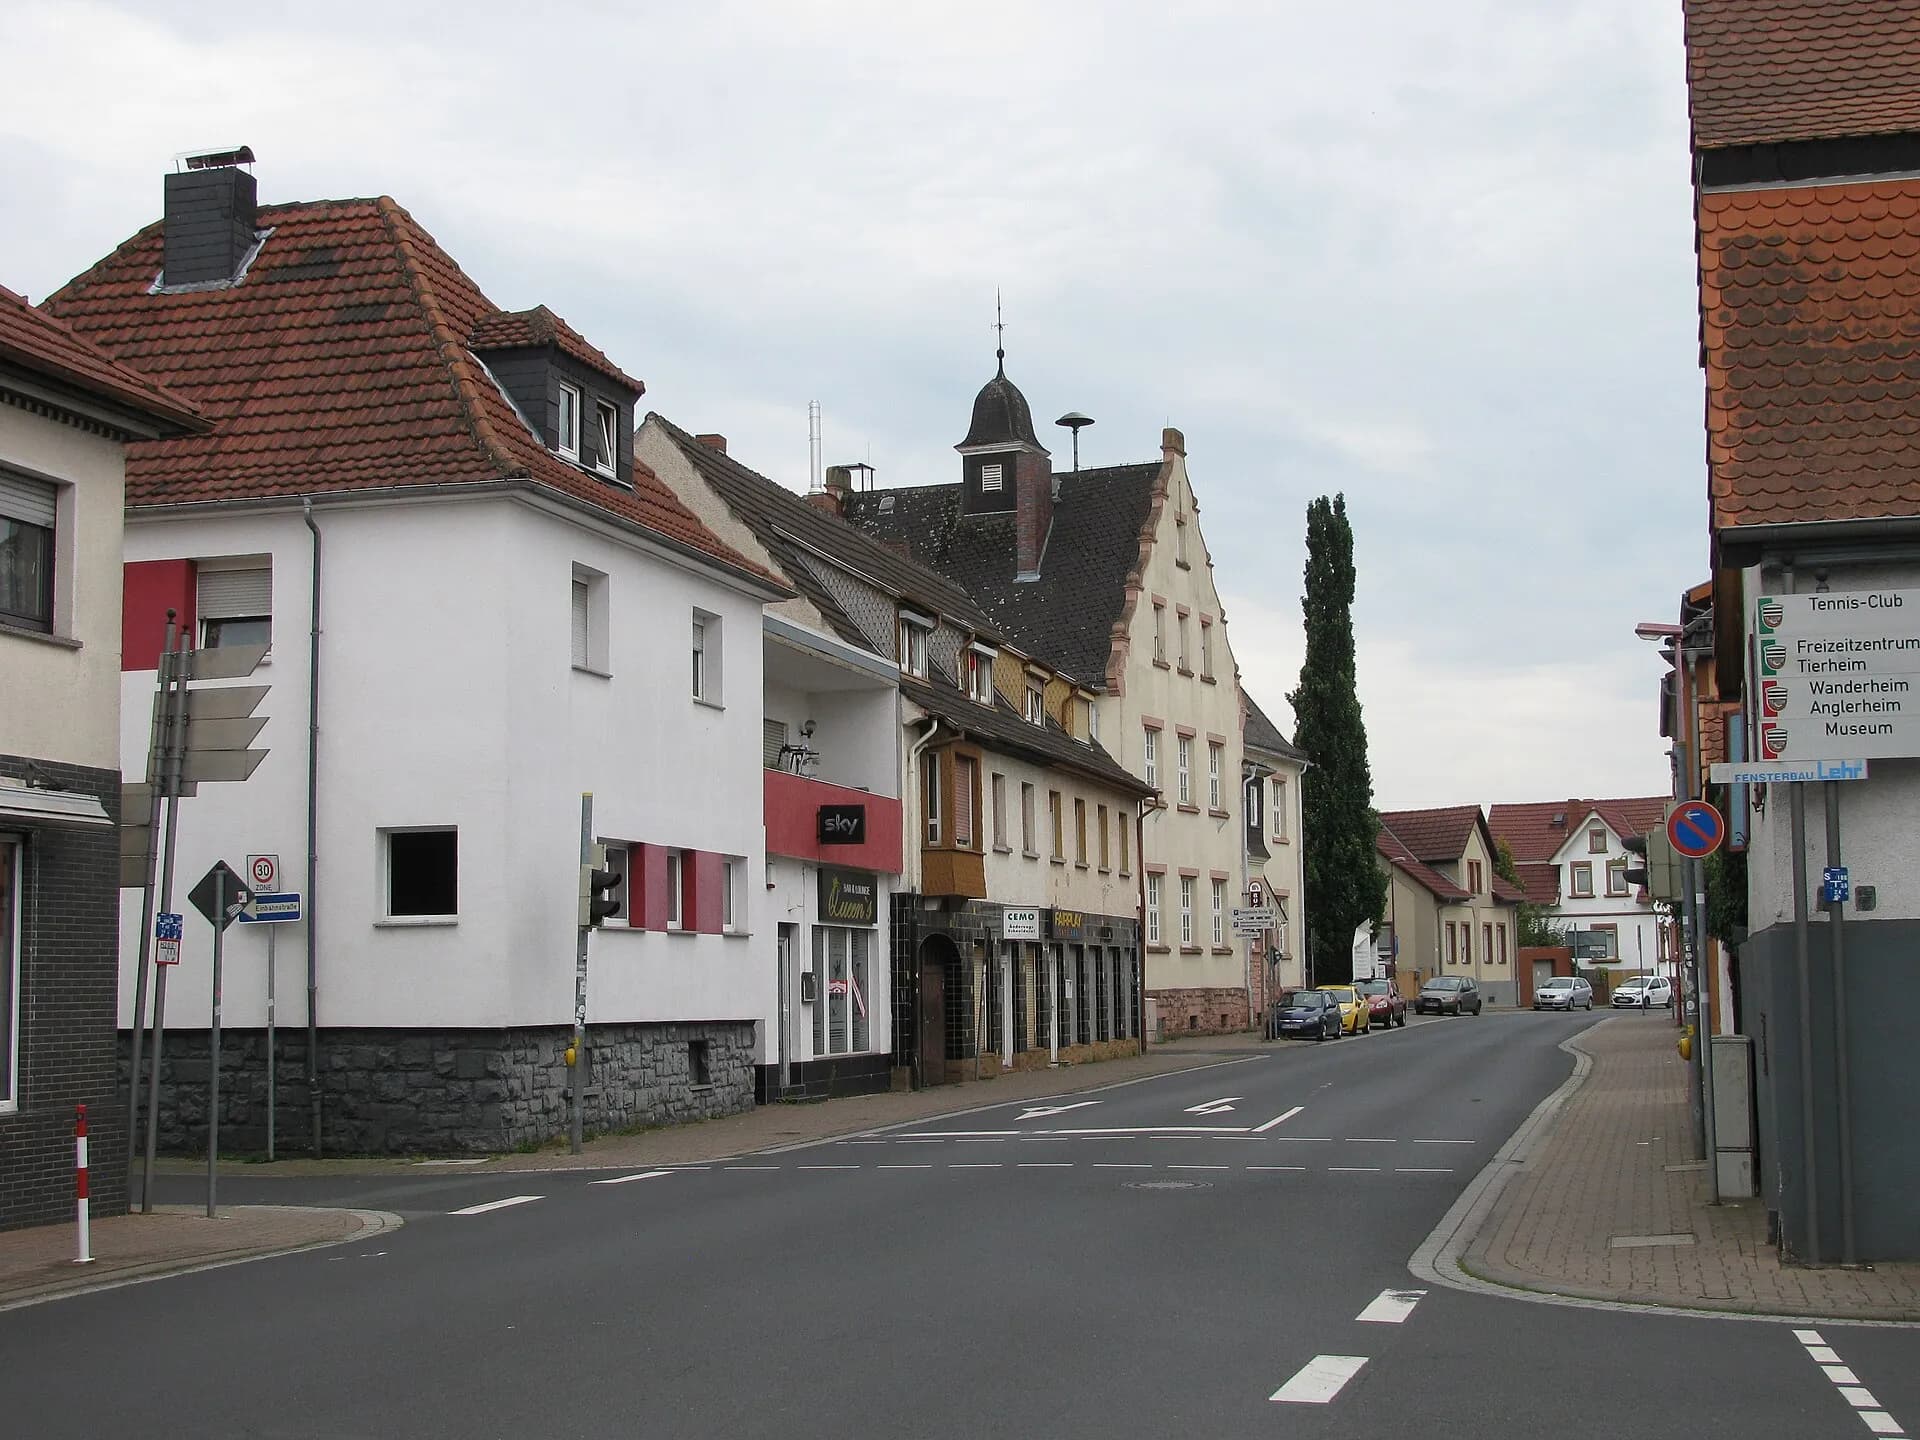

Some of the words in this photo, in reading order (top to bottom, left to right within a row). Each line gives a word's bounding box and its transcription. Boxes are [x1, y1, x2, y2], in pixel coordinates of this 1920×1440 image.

[1808, 593, 1903, 611] Tennis-Club
[1797, 637, 1920, 654] Freizeitzentrum
[1797, 658, 1867, 673] Tierheim
[1809, 678, 1909, 695] Wanderheim
[1810, 698, 1901, 717] Anglerheim
[1825, 722, 1893, 736] Museum
[1734, 771, 1814, 783] FENSTERBAU
[1816, 760, 1863, 780] Lehr
[824, 813, 859, 836] sky
[256, 864, 270, 877] 30
[255, 883, 273, 892] ZONE
[255, 903, 298, 912] Einbahnstraße
[1007, 912, 1035, 921] CEMO
